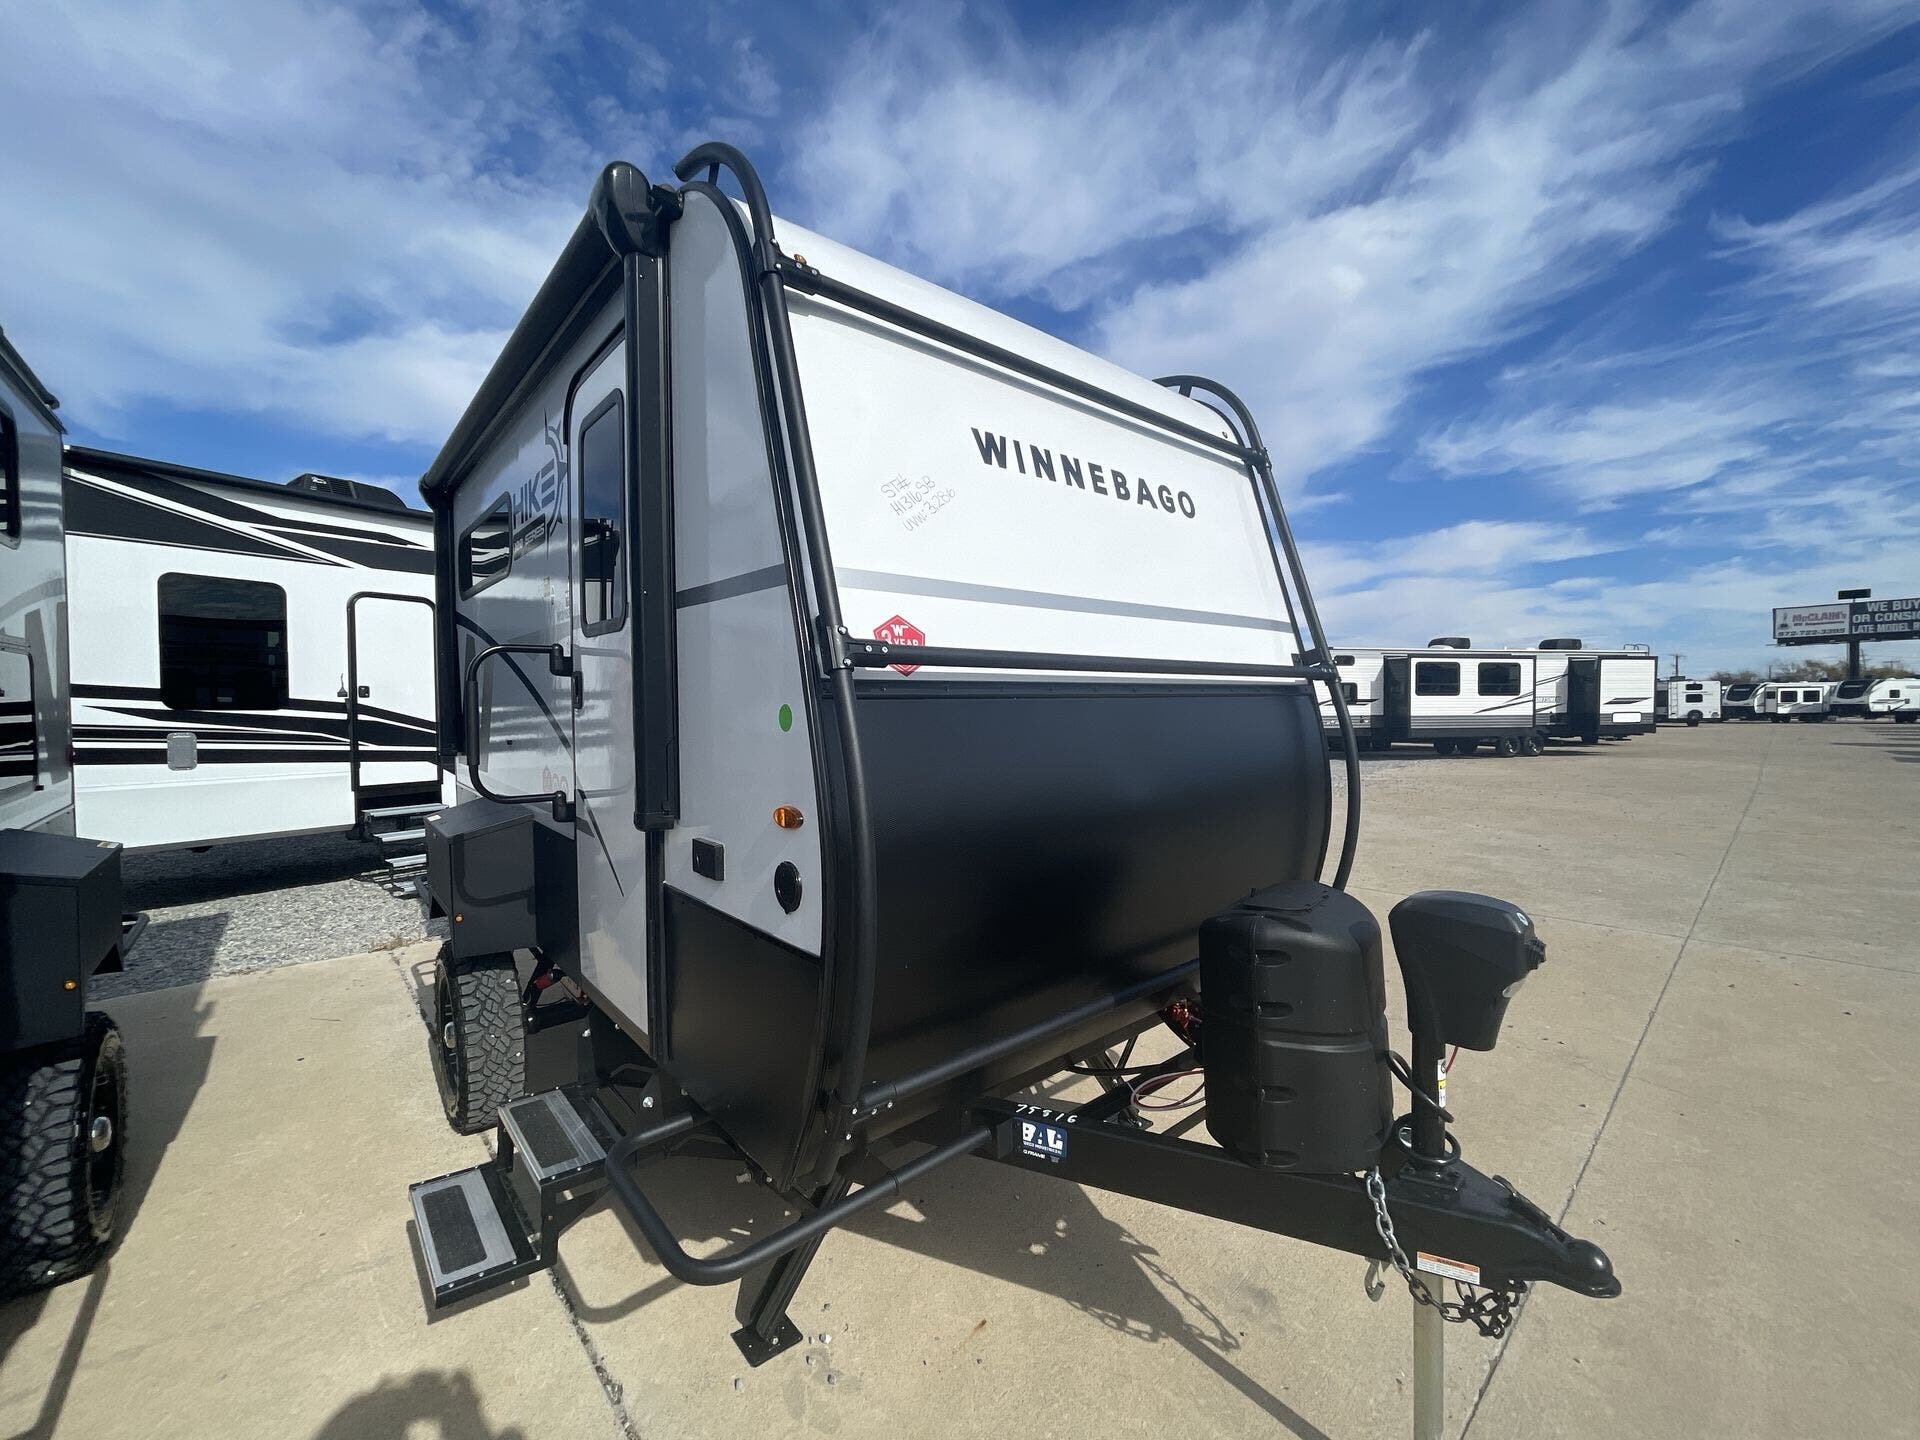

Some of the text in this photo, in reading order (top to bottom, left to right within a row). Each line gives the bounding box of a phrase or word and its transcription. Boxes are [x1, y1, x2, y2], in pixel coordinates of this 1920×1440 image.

[971, 426, 1196, 519] WINNEBAGO
[513, 458, 555, 531] HIKE
[1867, 601, 1888, 612] WE
[1852, 614, 1870, 624] OR
[1852, 624, 1875, 634] LATE
